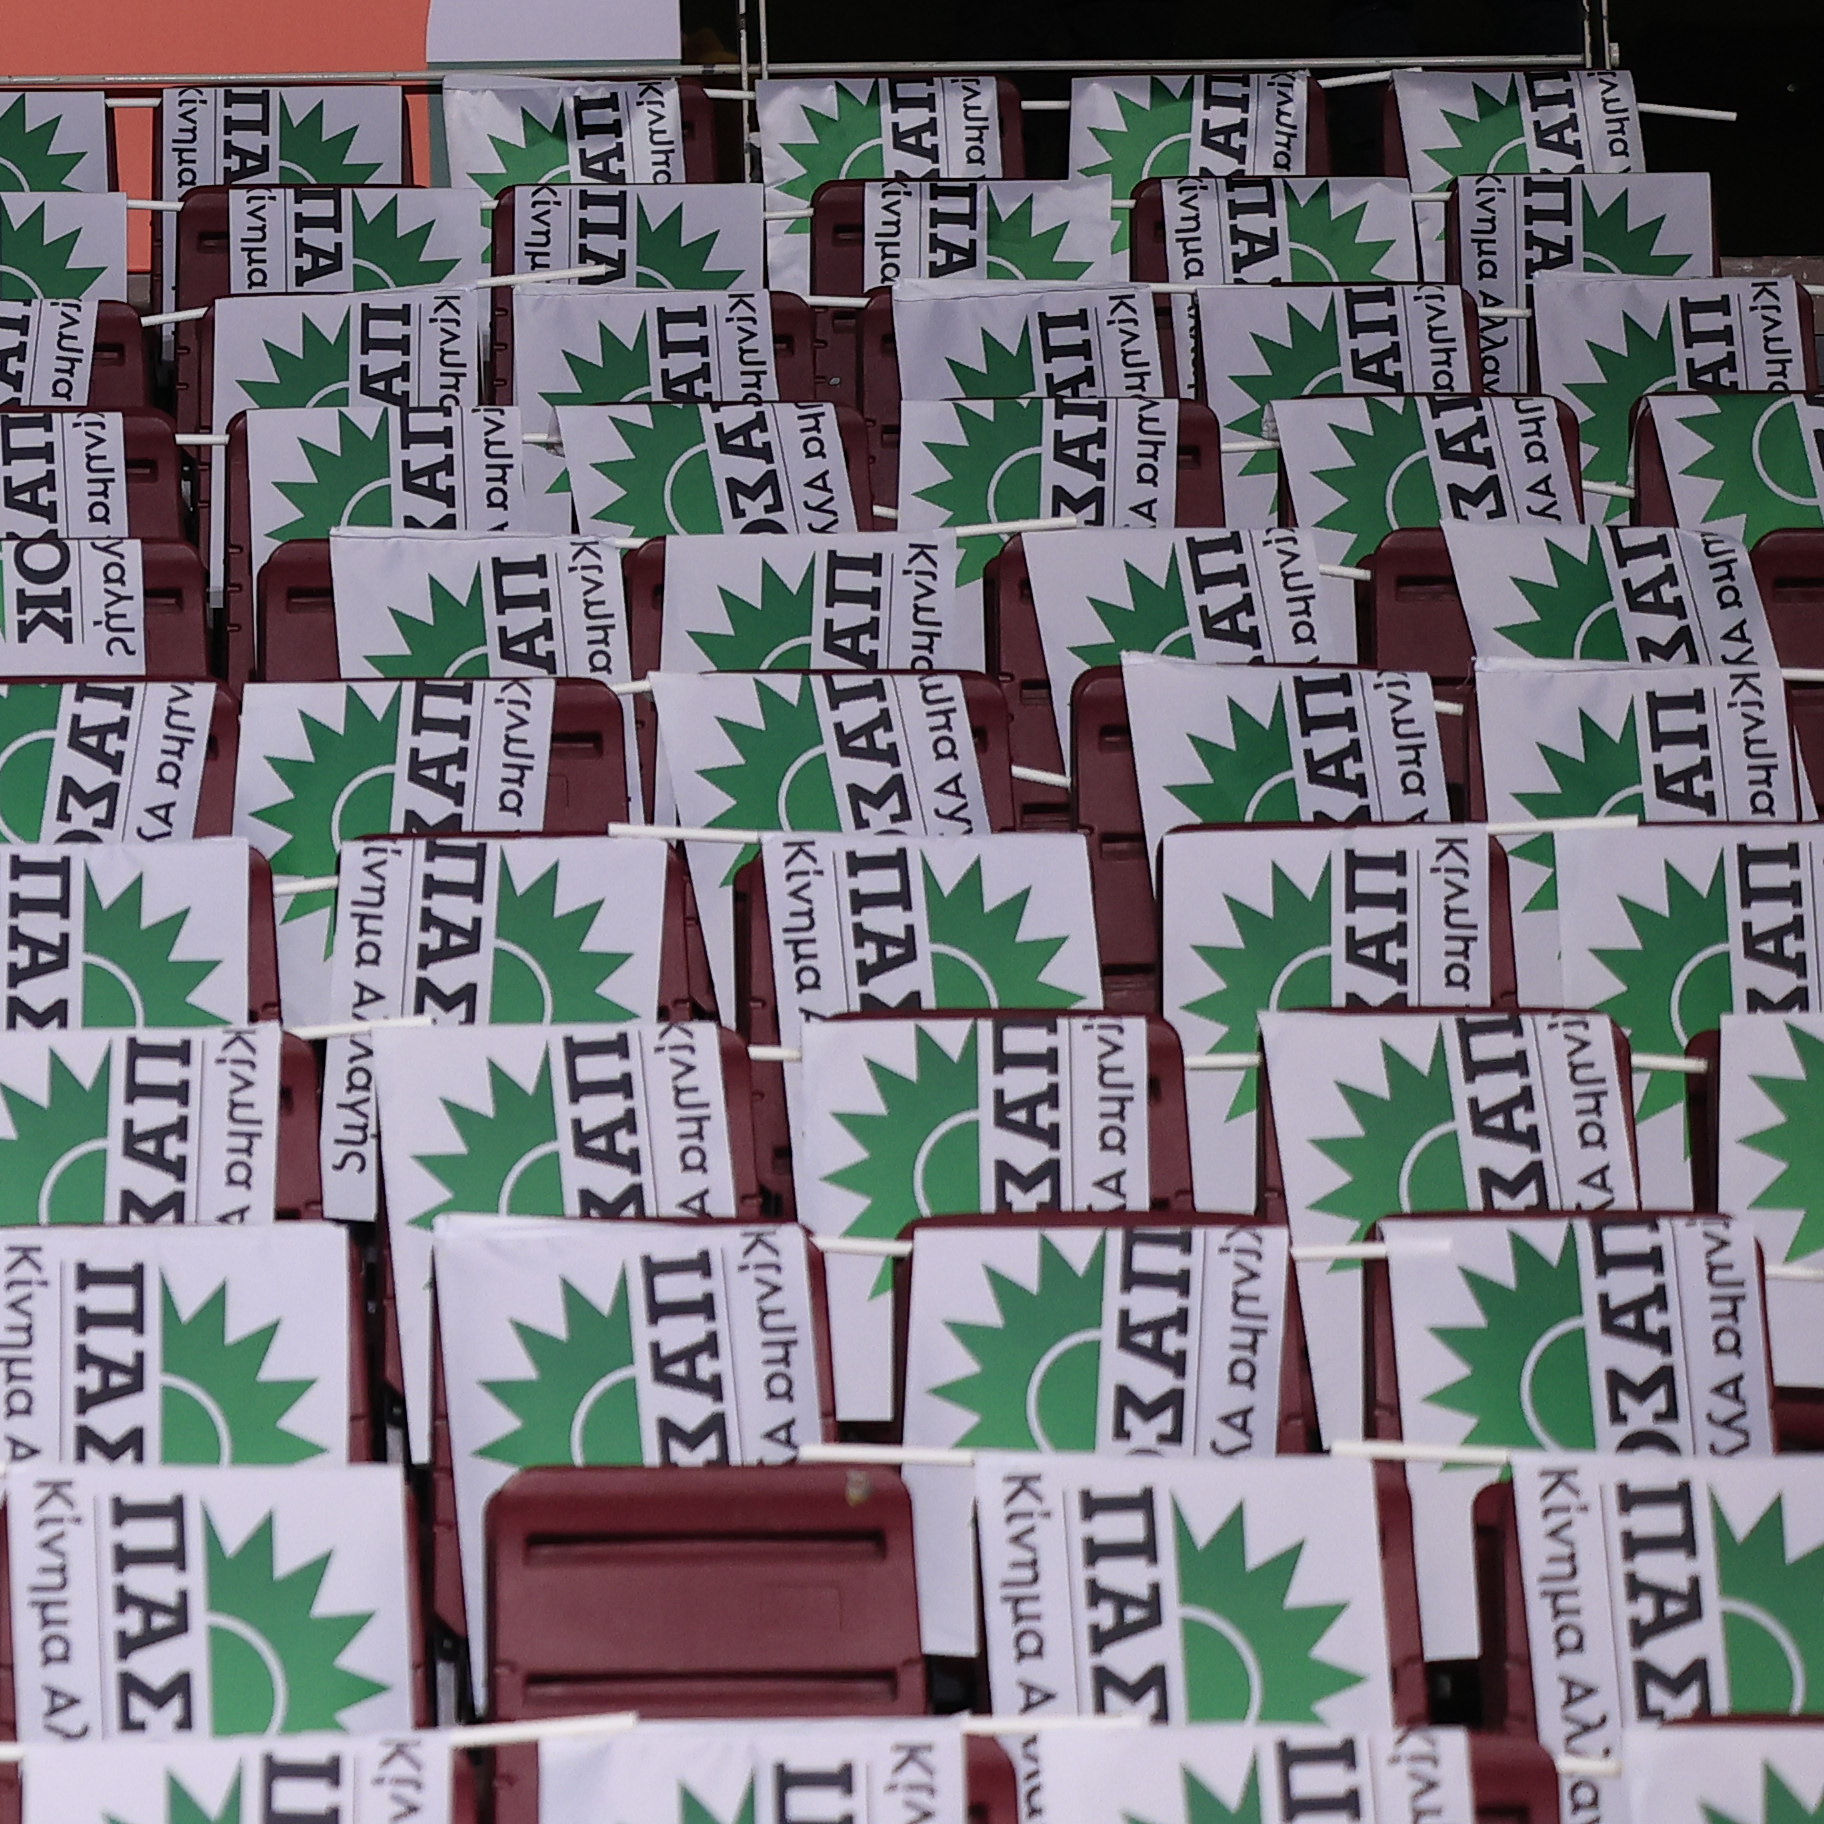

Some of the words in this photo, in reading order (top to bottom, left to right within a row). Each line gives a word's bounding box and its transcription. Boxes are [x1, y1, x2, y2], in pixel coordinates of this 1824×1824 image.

[7, 855, 70, 1029] ΠΑΣ
[351, 840, 402, 967] ίνημα
[415, 840, 481, 1024] ΠΑΣ
[782, 841, 824, 994] Κίνημα
[77, 1263, 144, 1462] ΠΑΣ
[28, 1480, 82, 1668] Κίνημα
[113, 1495, 192, 1731] ΠΑΣ
[1000, 1474, 1051, 1664] Κίνημα
[1082, 1488, 1168, 1723] ΠΑΣ
[1539, 1469, 1588, 1659] Κίνημα
[1618, 1481, 1715, 1722] ΠΑΣ
